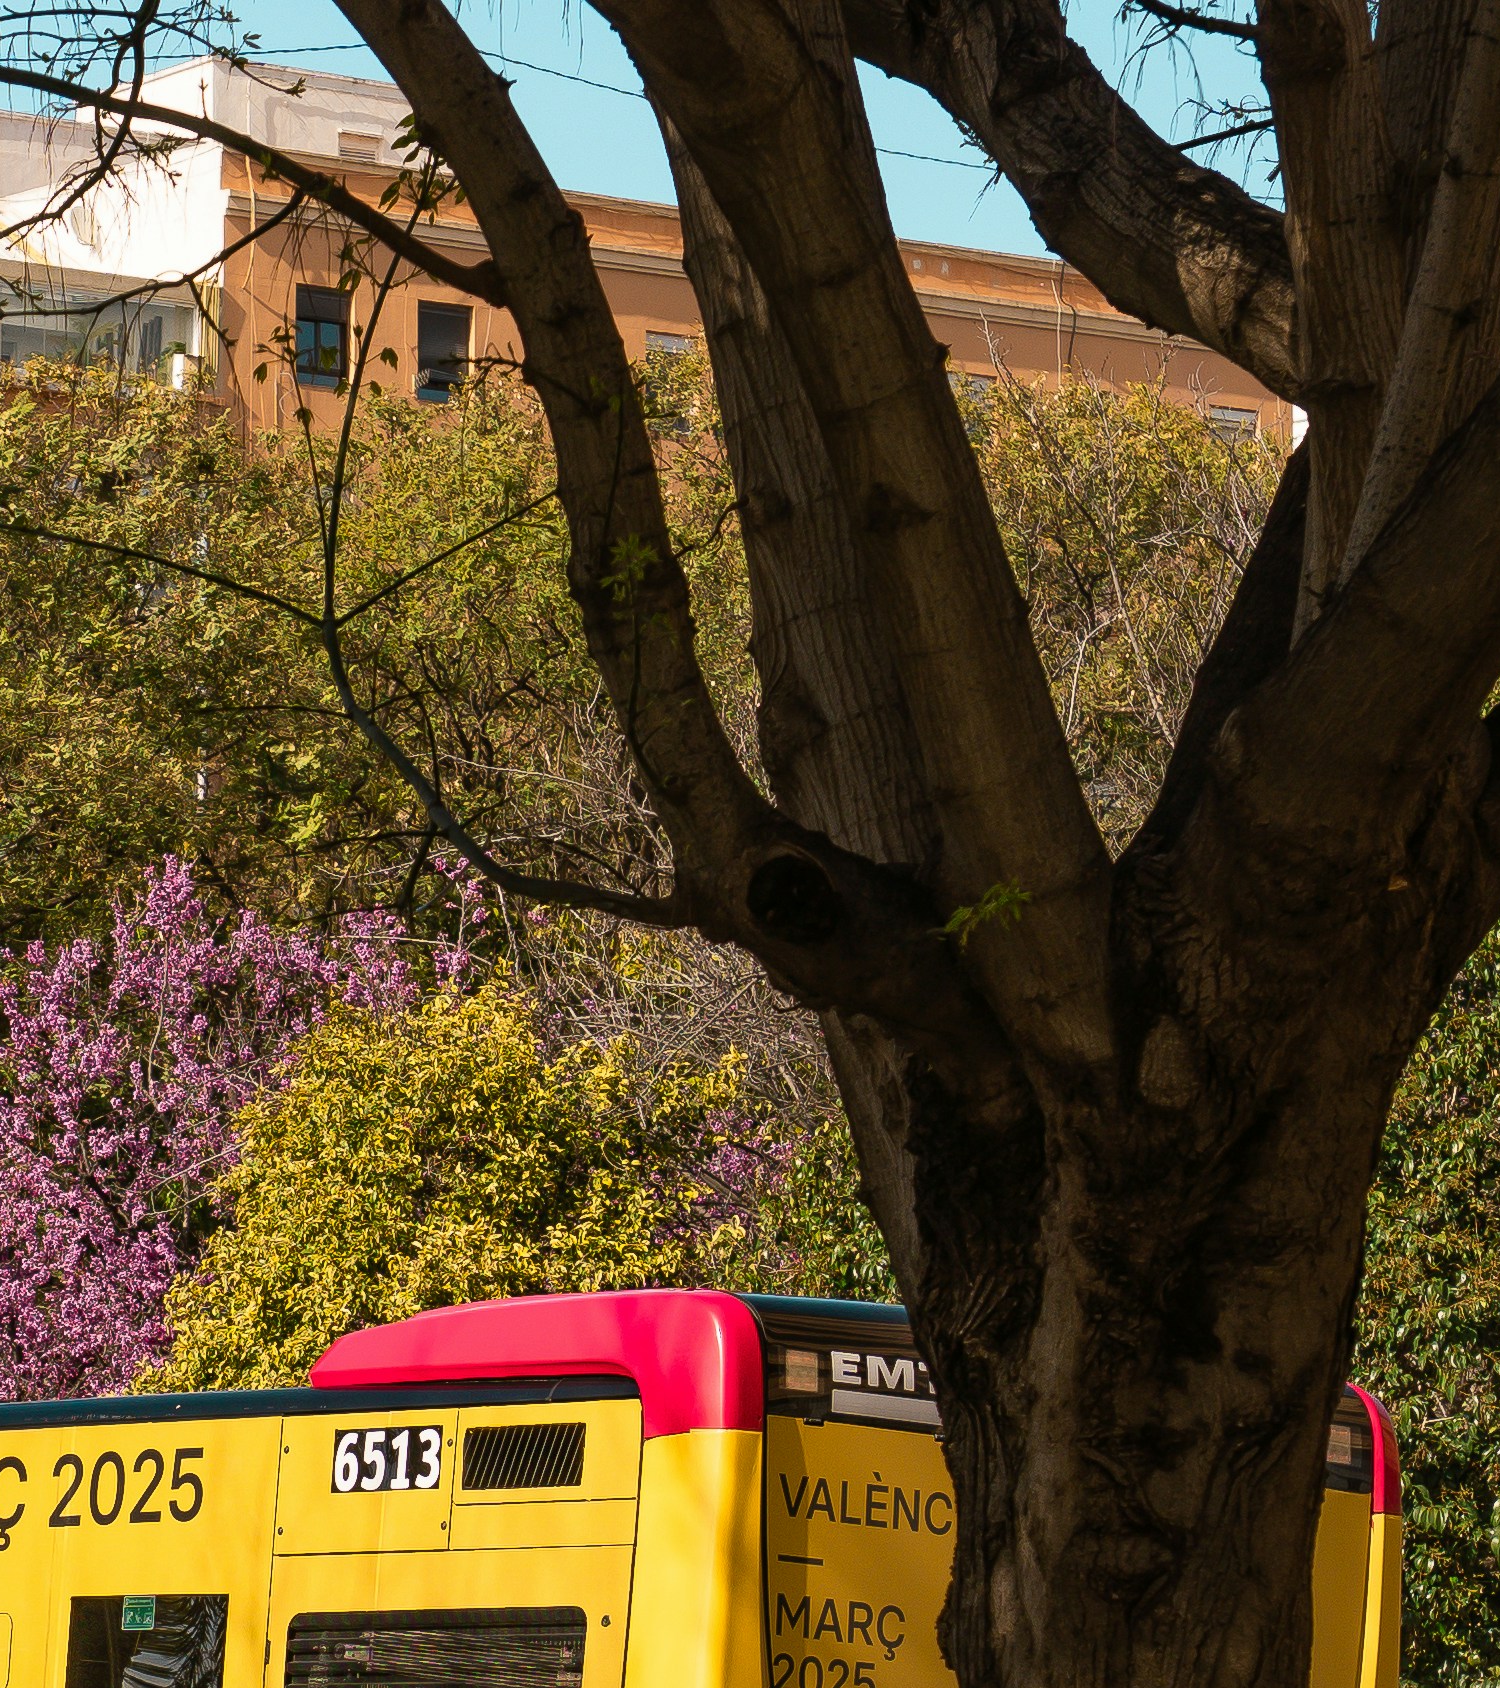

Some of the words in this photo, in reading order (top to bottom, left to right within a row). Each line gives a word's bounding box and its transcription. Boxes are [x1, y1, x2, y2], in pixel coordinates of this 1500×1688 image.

[48, 1447, 205, 1528] 2025
[333, 1427, 442, 1492] 6513
[778, 1471, 953, 1537] VALÈNC
[775, 1592, 906, 1662] MARÇ
